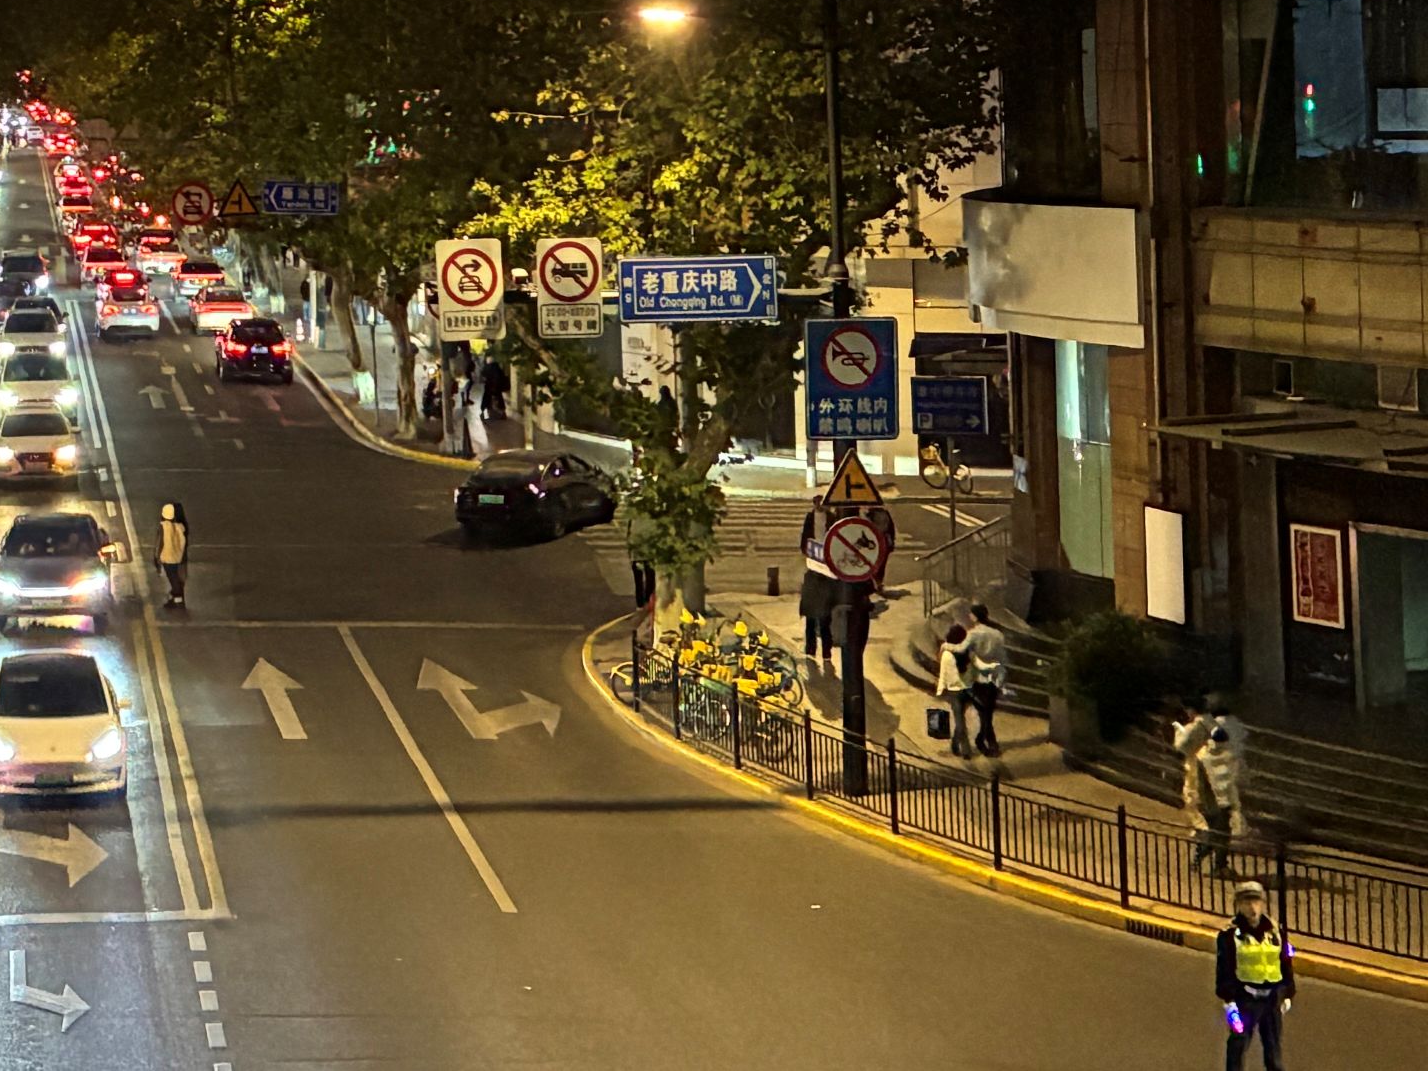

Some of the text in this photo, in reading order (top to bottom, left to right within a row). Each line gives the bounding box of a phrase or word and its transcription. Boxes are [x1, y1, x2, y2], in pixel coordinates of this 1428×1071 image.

[641, 268, 738, 294] 老重庆中路
[625, 293, 632, 303] S
[762, 290, 770, 300] N
[639, 297, 655, 308] Old
[659, 296, 707, 310] Chongqing
[819, 397, 888, 414] 外环线内
